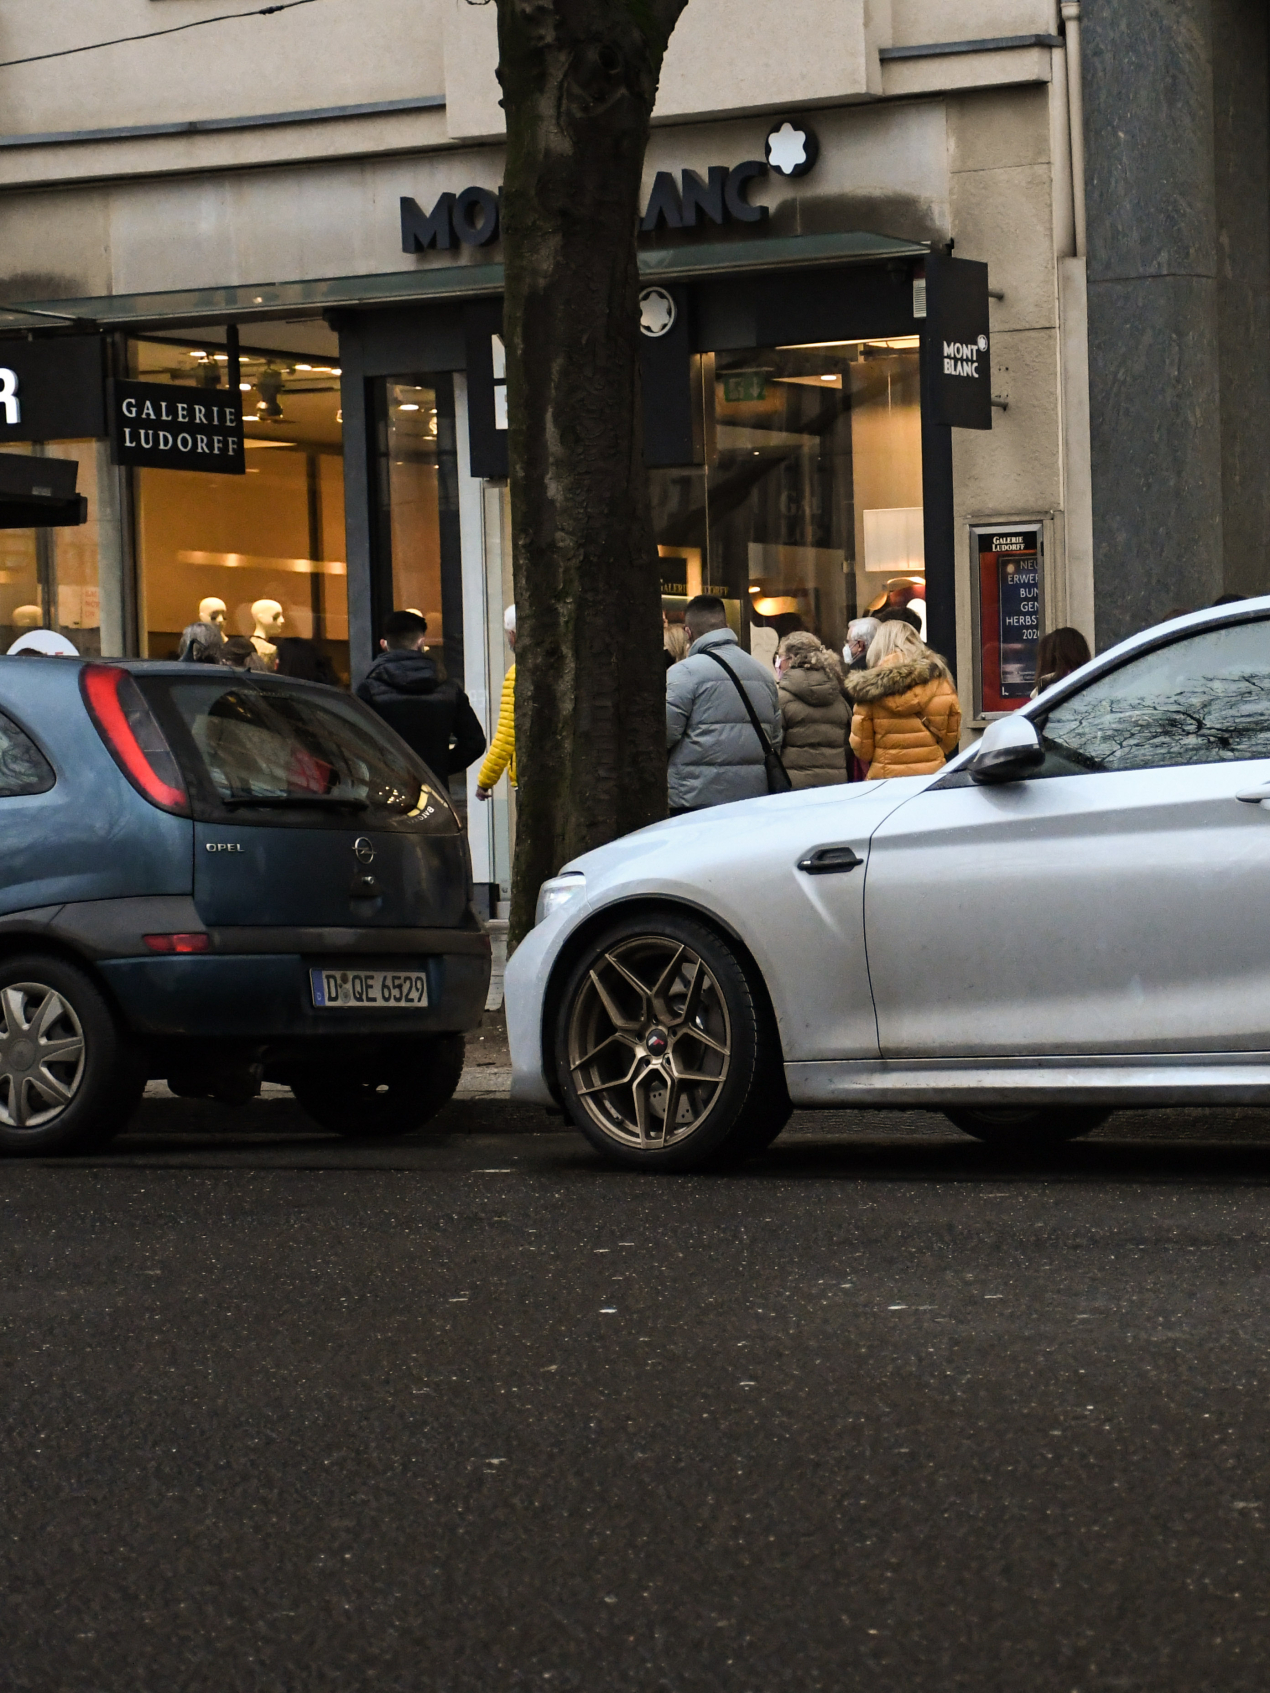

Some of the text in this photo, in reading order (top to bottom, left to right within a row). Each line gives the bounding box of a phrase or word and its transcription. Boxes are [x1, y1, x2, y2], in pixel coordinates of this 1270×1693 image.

[943, 340, 979, 361] MONT
[943, 358, 979, 378] BLANC
[122, 398, 237, 427] GALERIE
[123, 428, 238, 456] LUDORFF
[992, 543, 1025, 551] LUDORFF
[993, 536, 1024, 545] GALERIE
[1022, 629, 1040, 640] 202
[205, 843, 245, 852] OPEL
[381, 975, 425, 1003] 6529
